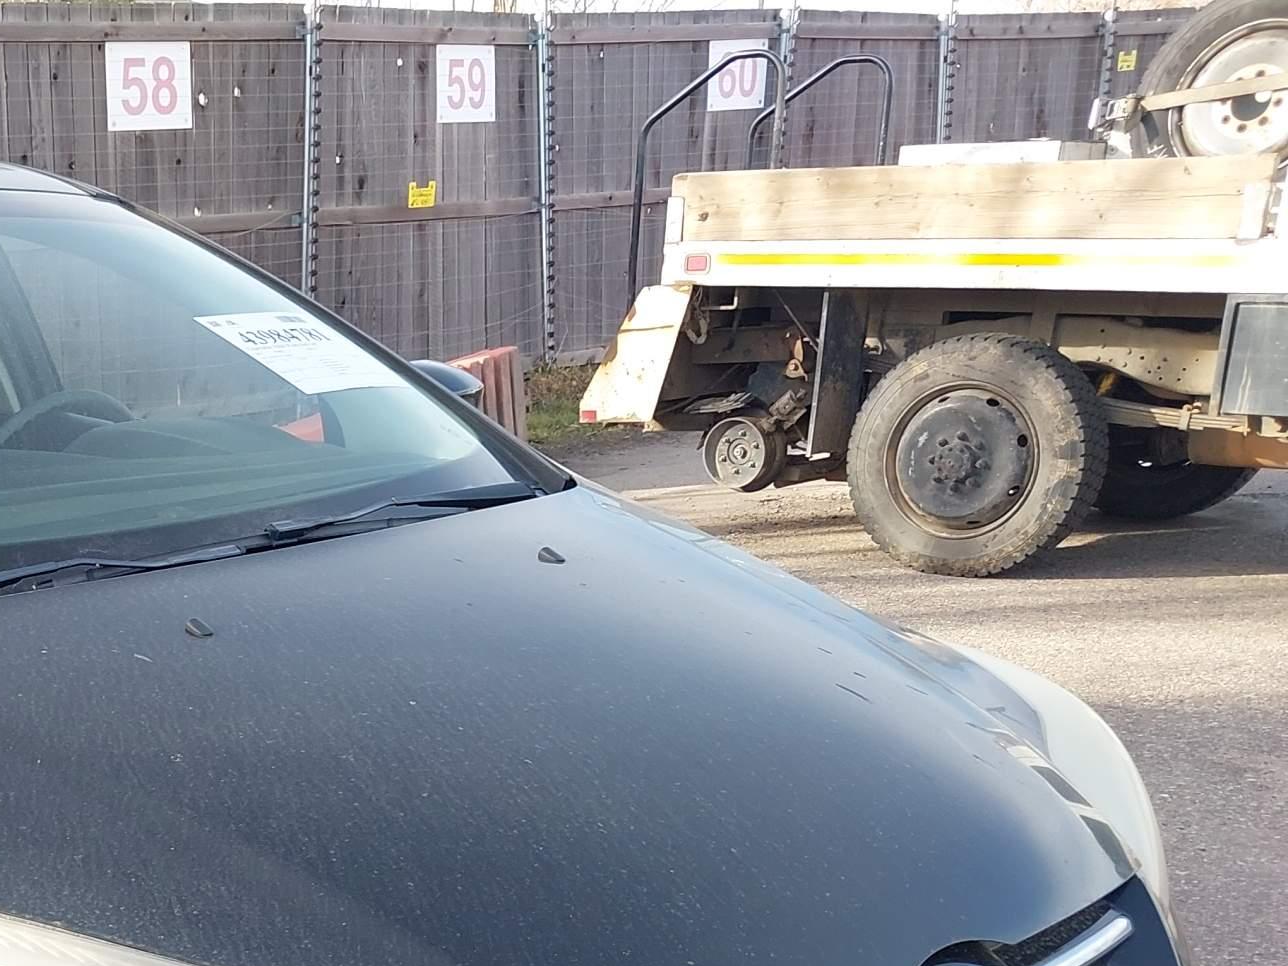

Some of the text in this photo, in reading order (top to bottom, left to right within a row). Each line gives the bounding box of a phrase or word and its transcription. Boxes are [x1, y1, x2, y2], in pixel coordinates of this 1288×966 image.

[122, 57, 178, 116] 58
[447, 58, 486, 110] 59
[237, 328, 332, 345] 43984781
